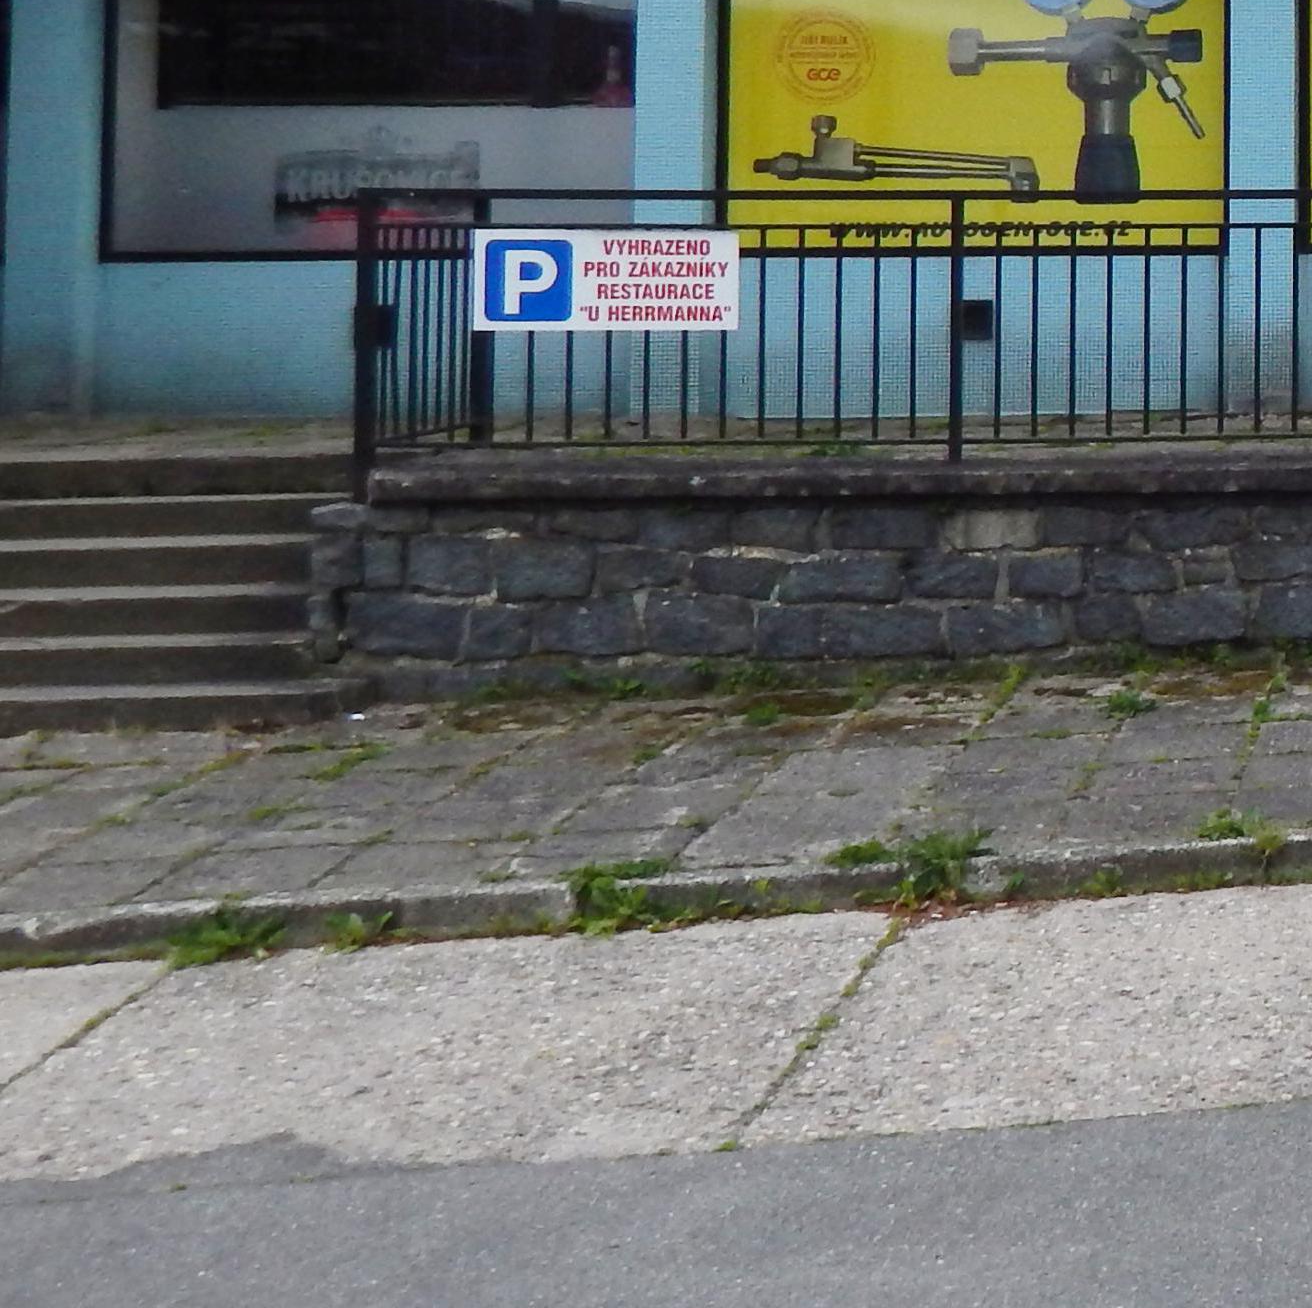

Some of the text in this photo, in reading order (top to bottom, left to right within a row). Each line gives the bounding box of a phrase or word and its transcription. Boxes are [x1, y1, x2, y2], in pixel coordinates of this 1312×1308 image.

[602, 239, 711, 256] VYHRAZENO
[583, 257, 729, 278] PRO ZÁKAZNÍKY
[596, 283, 715, 300] RESTAURACE
